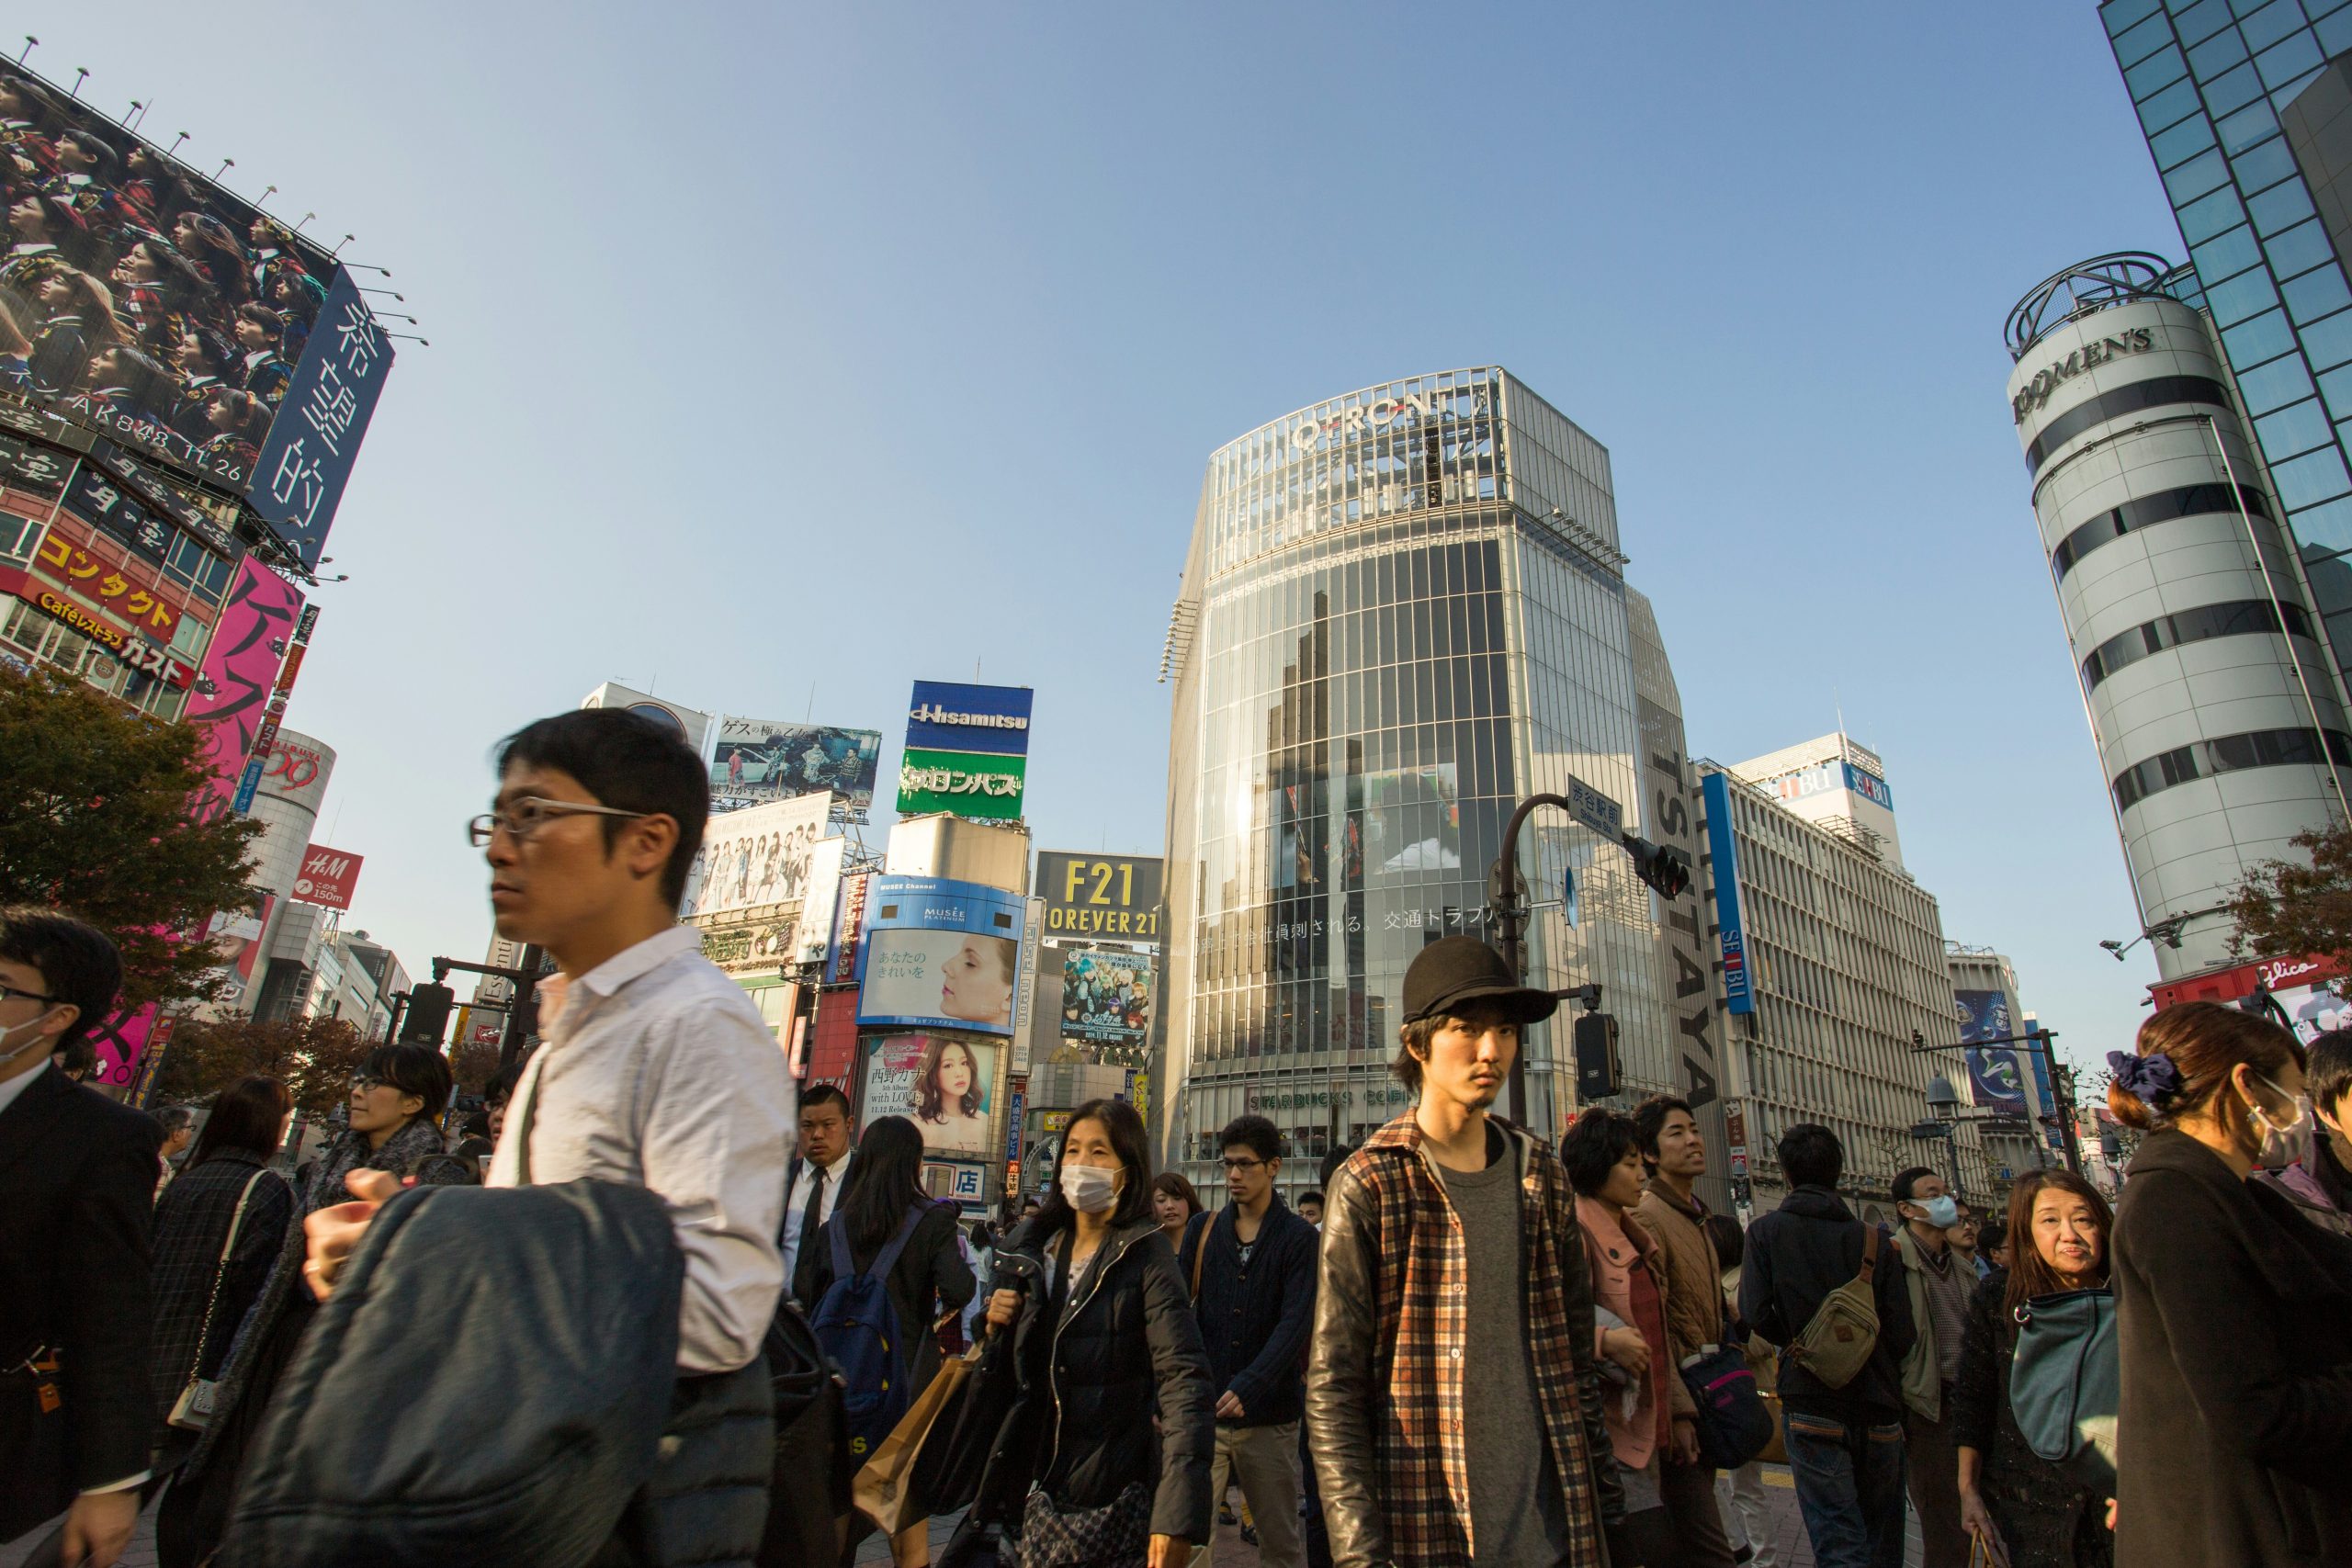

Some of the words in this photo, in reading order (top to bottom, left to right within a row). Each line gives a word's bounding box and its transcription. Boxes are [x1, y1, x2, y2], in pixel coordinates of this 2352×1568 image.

[72, 397, 169, 448] AKB48
[40, 534, 172, 626] コンタクト
[120, 637, 182, 681] ガスト
[910, 703, 1028, 729] Hisamitsu
[272, 740, 321, 763] HIBUYA
[264, 750, 319, 790] 09
[1572, 783, 1618, 826] 渋谷駅前
[1580, 808, 1601, 829] Shibuya
[305, 852, 350, 880] H&M
[313, 888, 343, 902] 150m
[316, 882, 337, 893] この先
[1065, 860, 1133, 906] F21
[1045, 906, 1130, 933] OREVER
[1136, 913, 1157, 935] 21
[878, 951, 926, 964] あなたの
[1721, 930, 1746, 998] SEIBU
[877, 966, 924, 979] きれいを
[2258, 961, 2319, 988] Glico
[1017, 979, 1031, 1027] neon
[871, 1066, 926, 1084] 西野カナ
[871, 1092, 889, 1103] with
[1250, 1090, 1352, 1110] STARBUCKS
[956, 1170, 978, 1193] 店
